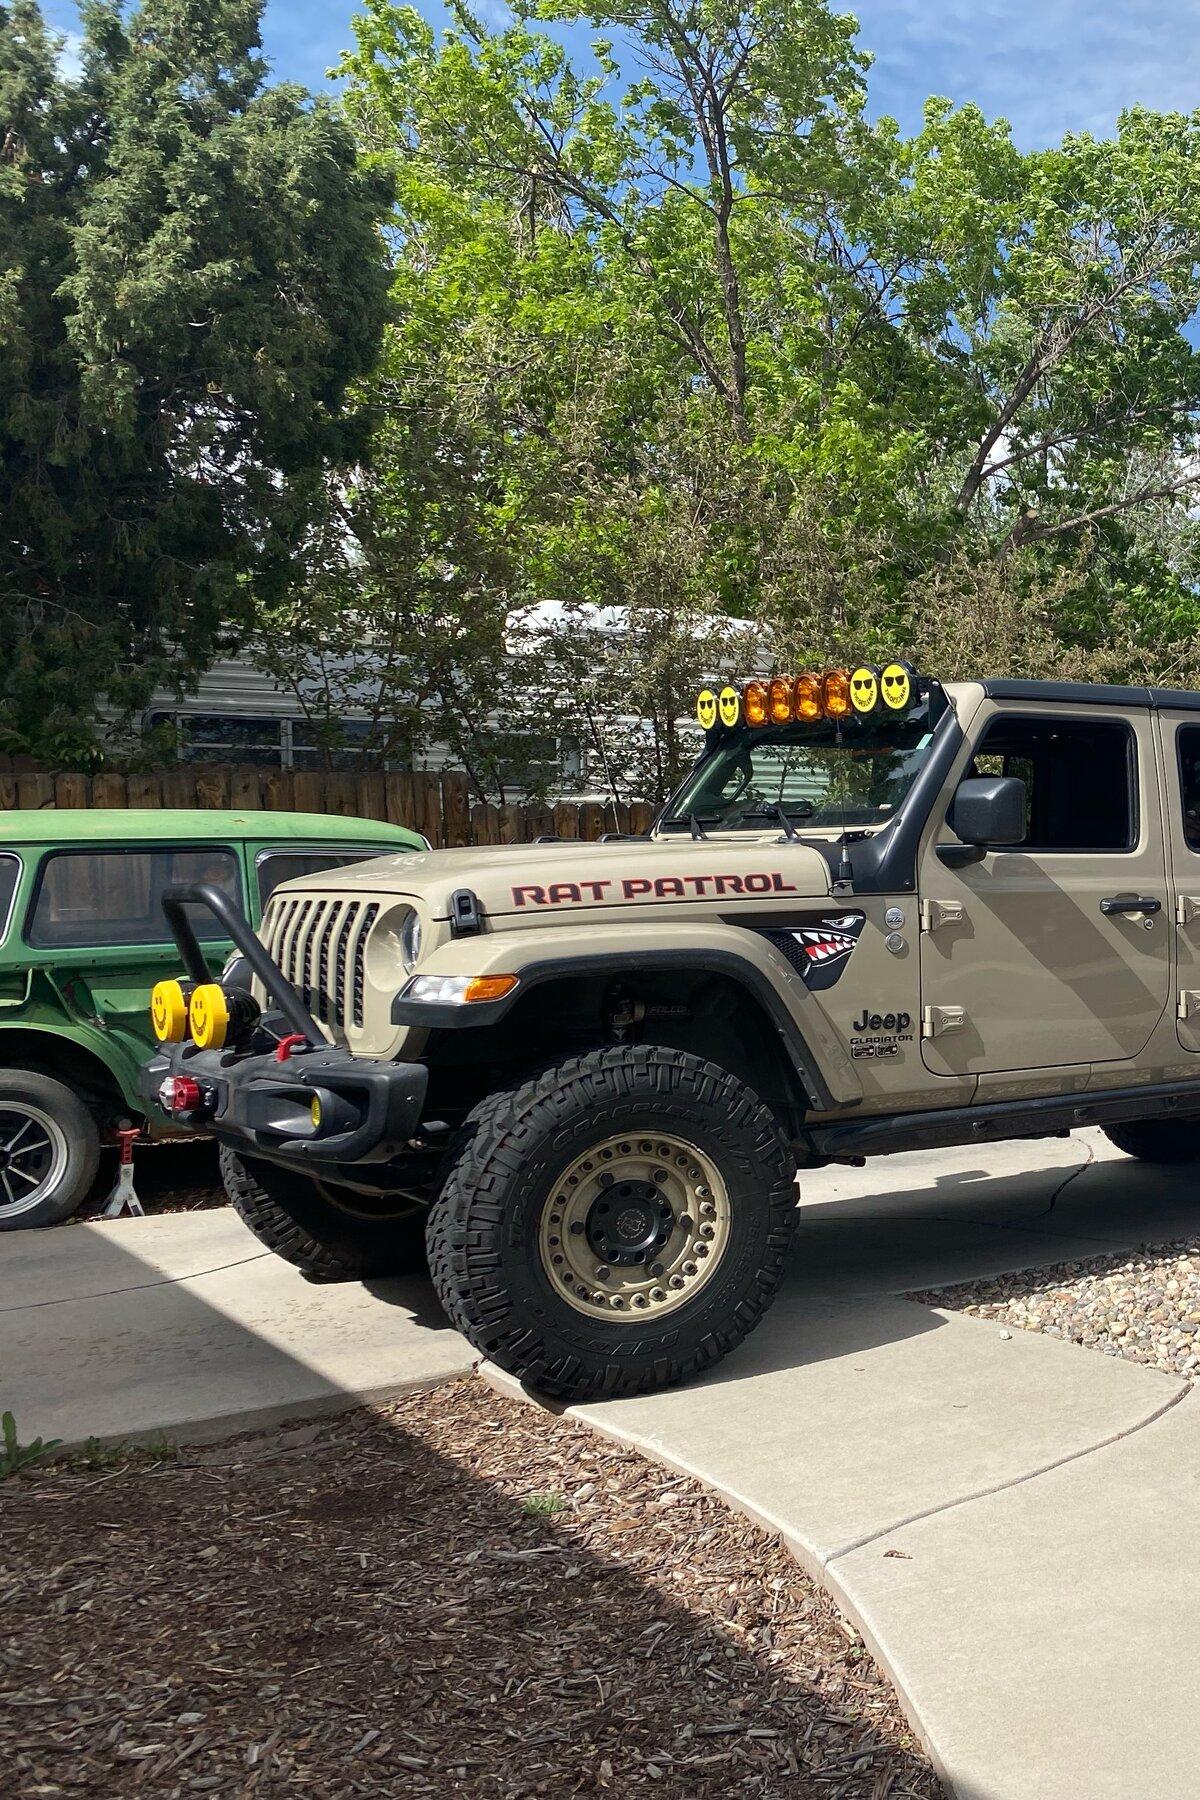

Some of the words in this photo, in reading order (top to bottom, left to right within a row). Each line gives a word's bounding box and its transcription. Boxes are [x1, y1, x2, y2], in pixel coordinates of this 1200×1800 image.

[511, 880, 612, 907] RAT
[621, 872, 799, 900] PATROL
[853, 1009, 911, 1034] Jeep
[850, 1034, 914, 1045] GLADIATOR
